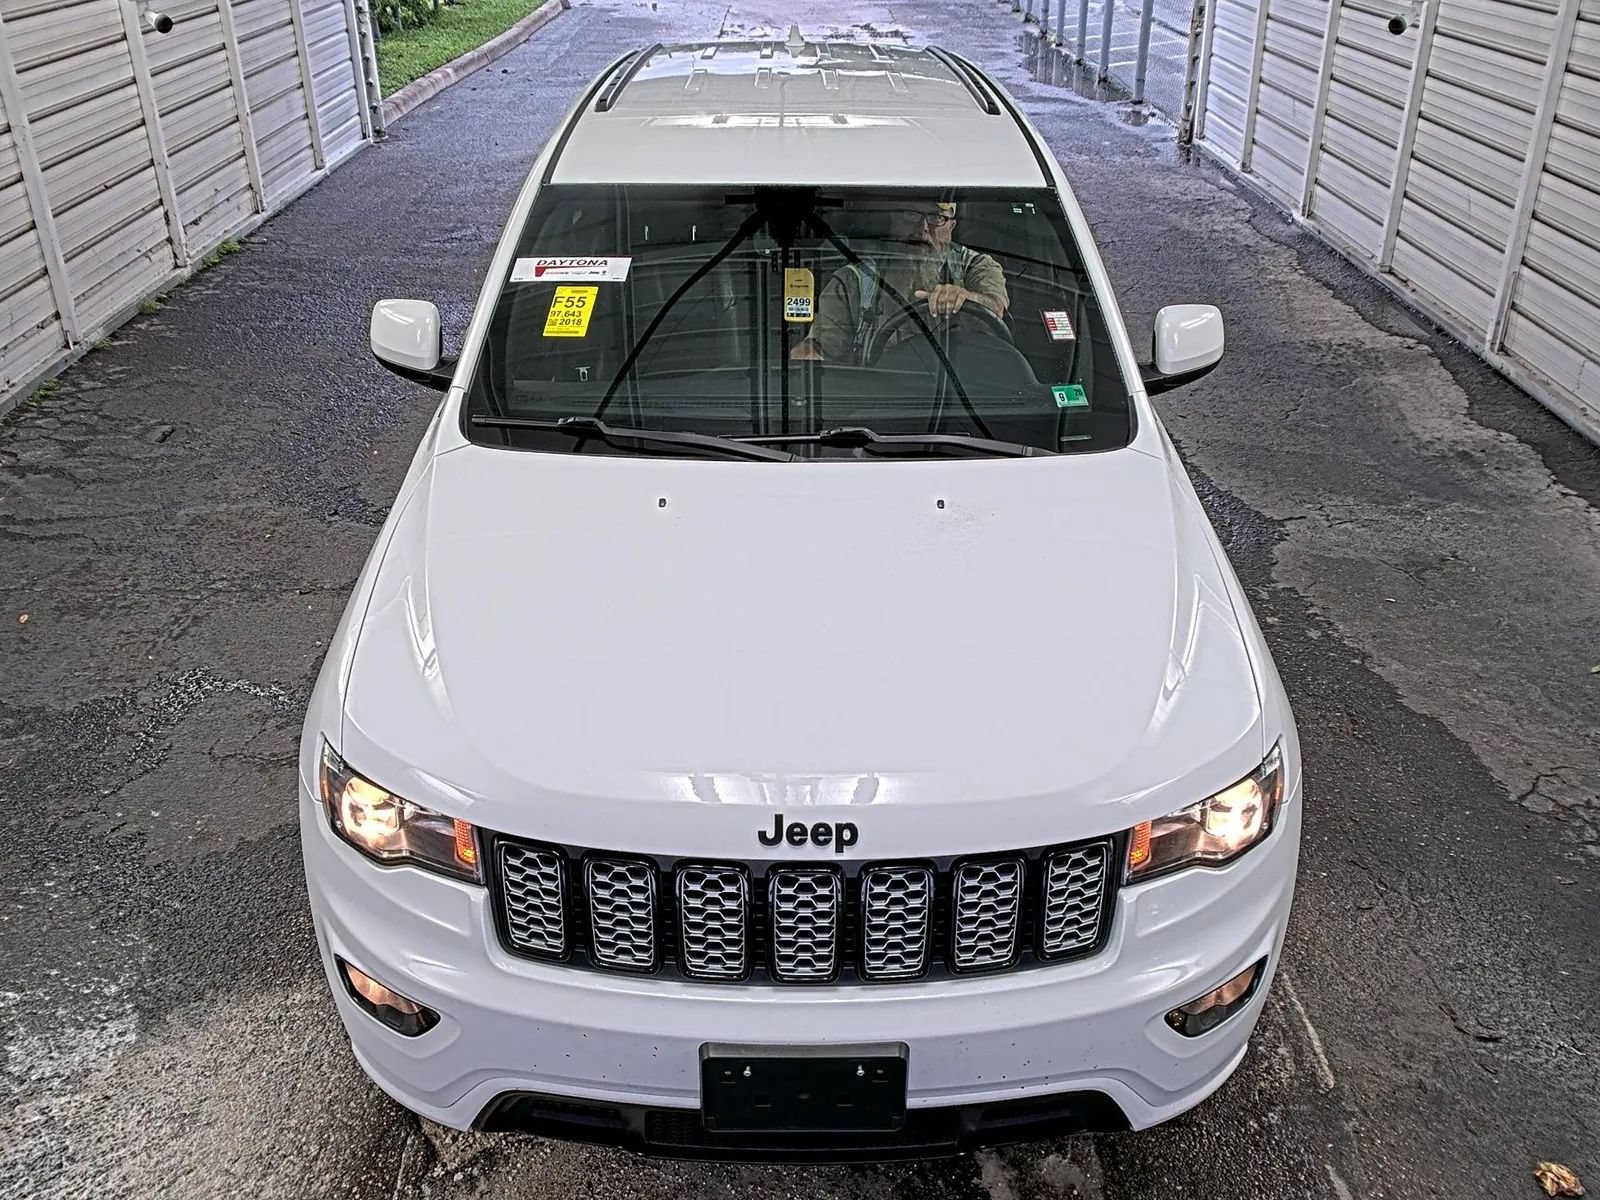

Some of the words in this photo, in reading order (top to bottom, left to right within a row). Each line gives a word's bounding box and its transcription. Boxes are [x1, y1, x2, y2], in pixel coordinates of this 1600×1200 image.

[552, 296, 587, 308] F55
[787, 297, 811, 306] 2499
[559, 318, 583, 326] 2018
[1058, 392, 1066, 402] 9
[757, 813, 859, 854] Jeep
